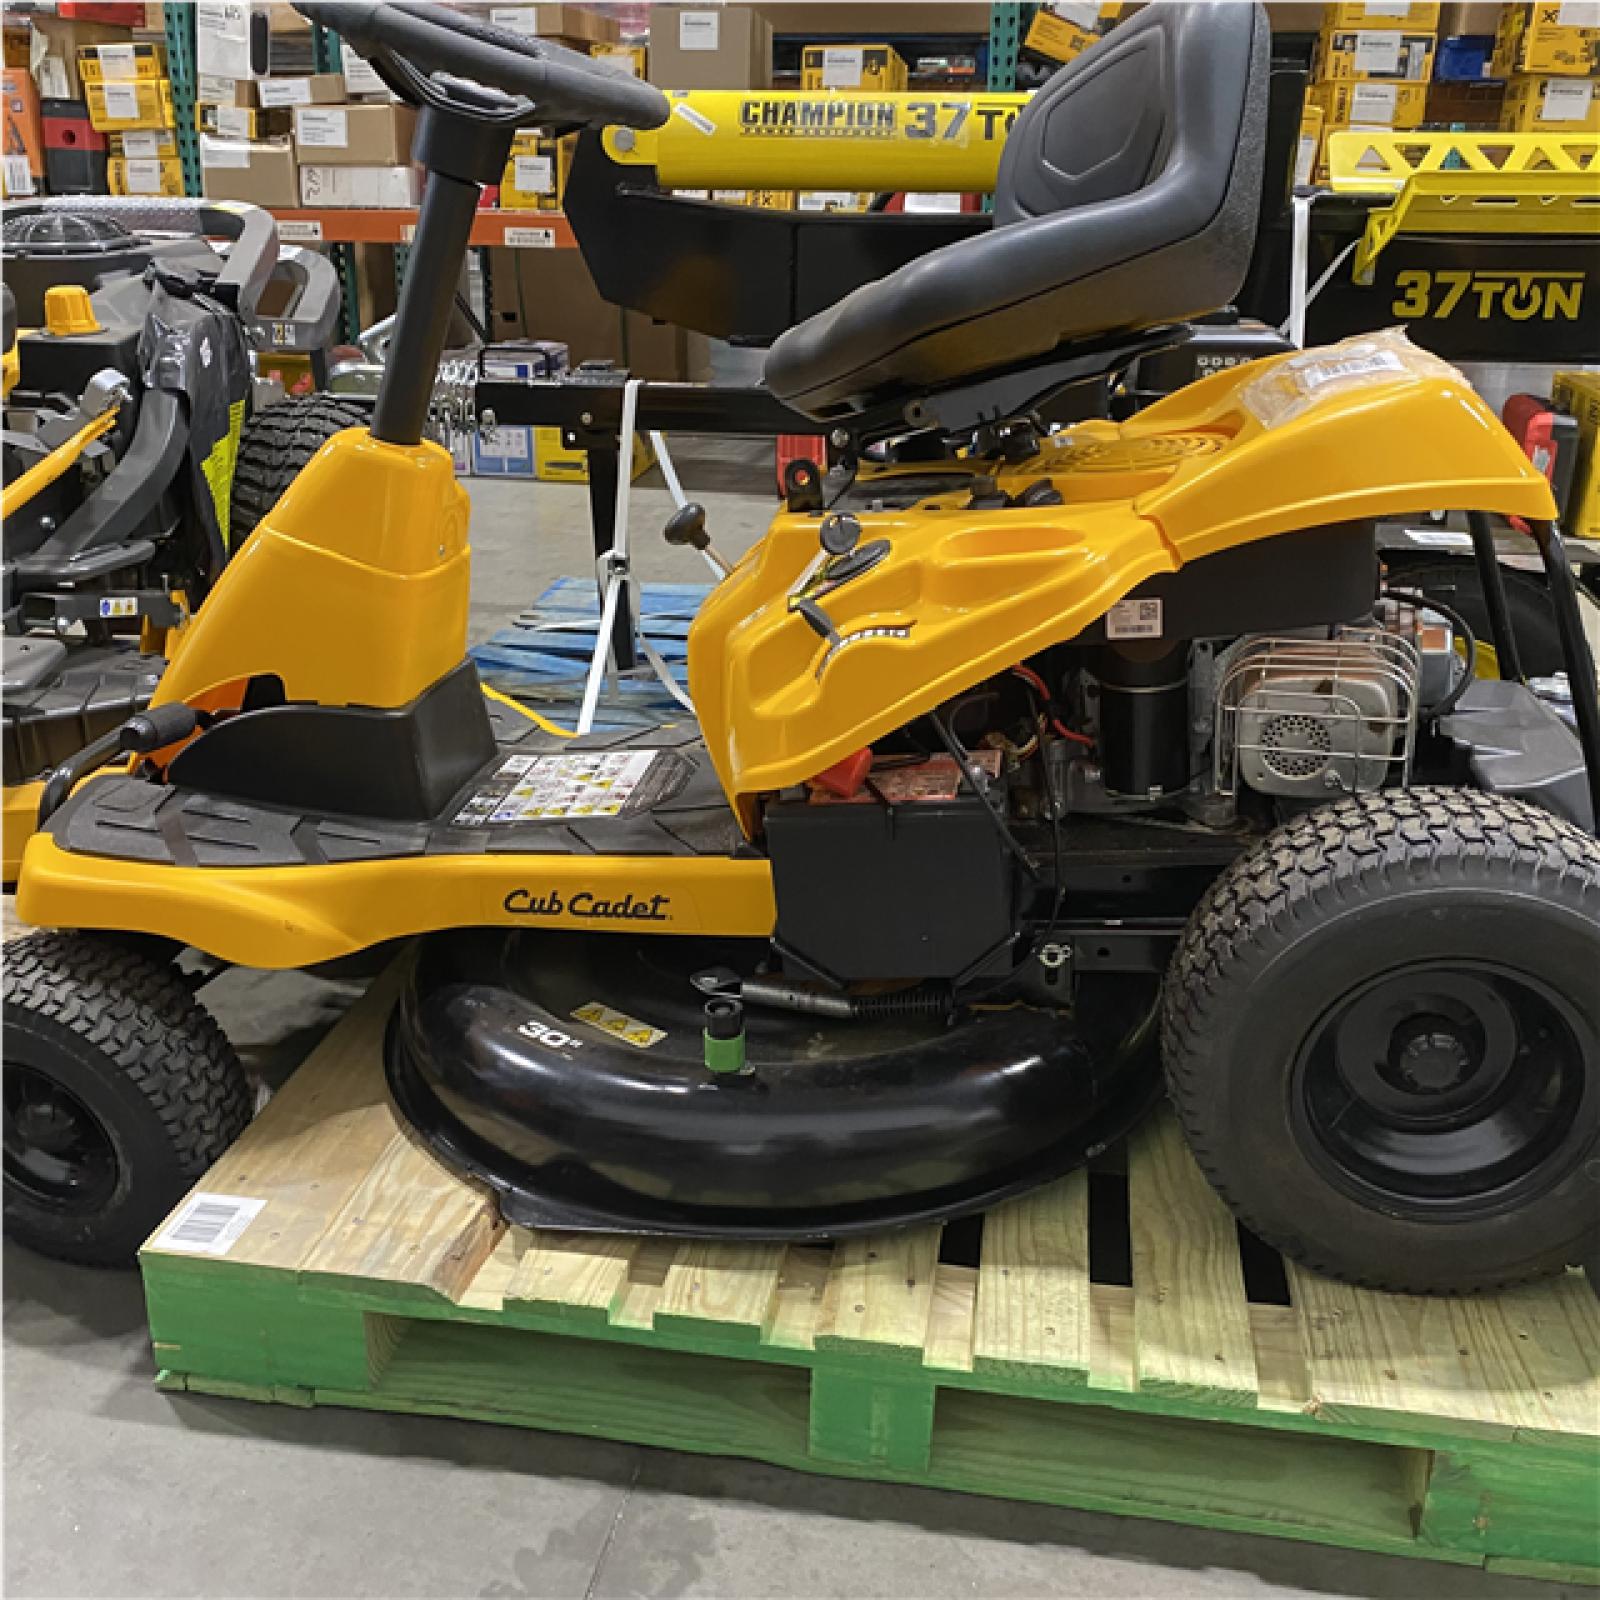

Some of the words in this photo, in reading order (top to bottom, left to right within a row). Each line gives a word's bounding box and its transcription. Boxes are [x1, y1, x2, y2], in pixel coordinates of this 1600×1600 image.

[742, 101, 895, 126] CHAMPION
[503, 888, 564, 916] Cub
[567, 891, 671, 921] Cadet
